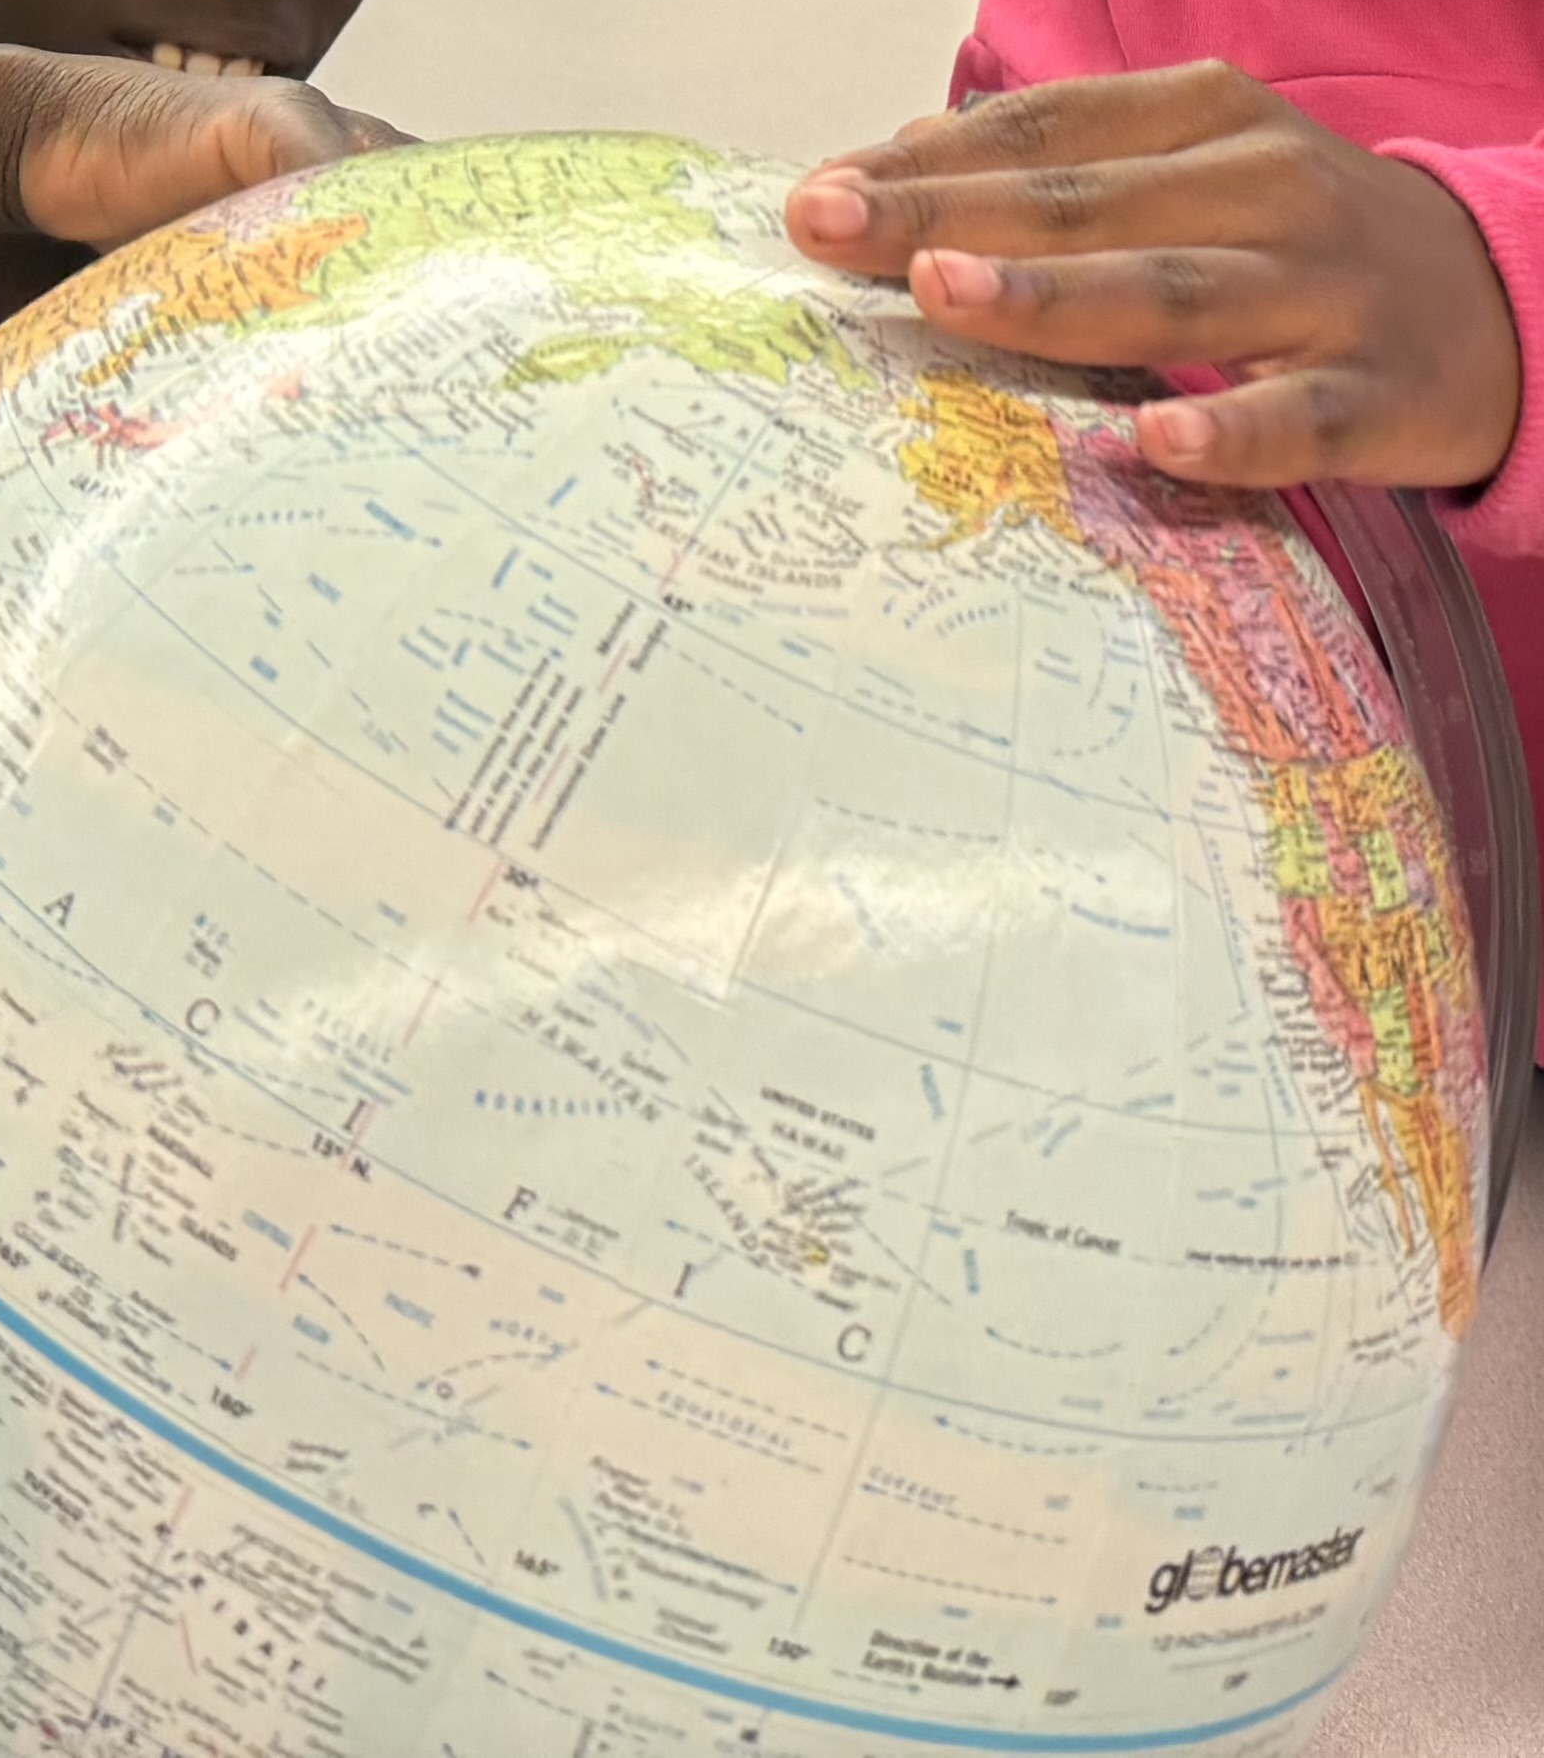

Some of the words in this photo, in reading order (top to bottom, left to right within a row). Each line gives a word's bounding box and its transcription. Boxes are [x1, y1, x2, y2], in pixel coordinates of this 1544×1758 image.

[1007, 1209, 1049, 1239] Tropic
[1054, 1218, 1070, 1243] of
[1074, 1226, 1120, 1255] Cancer
